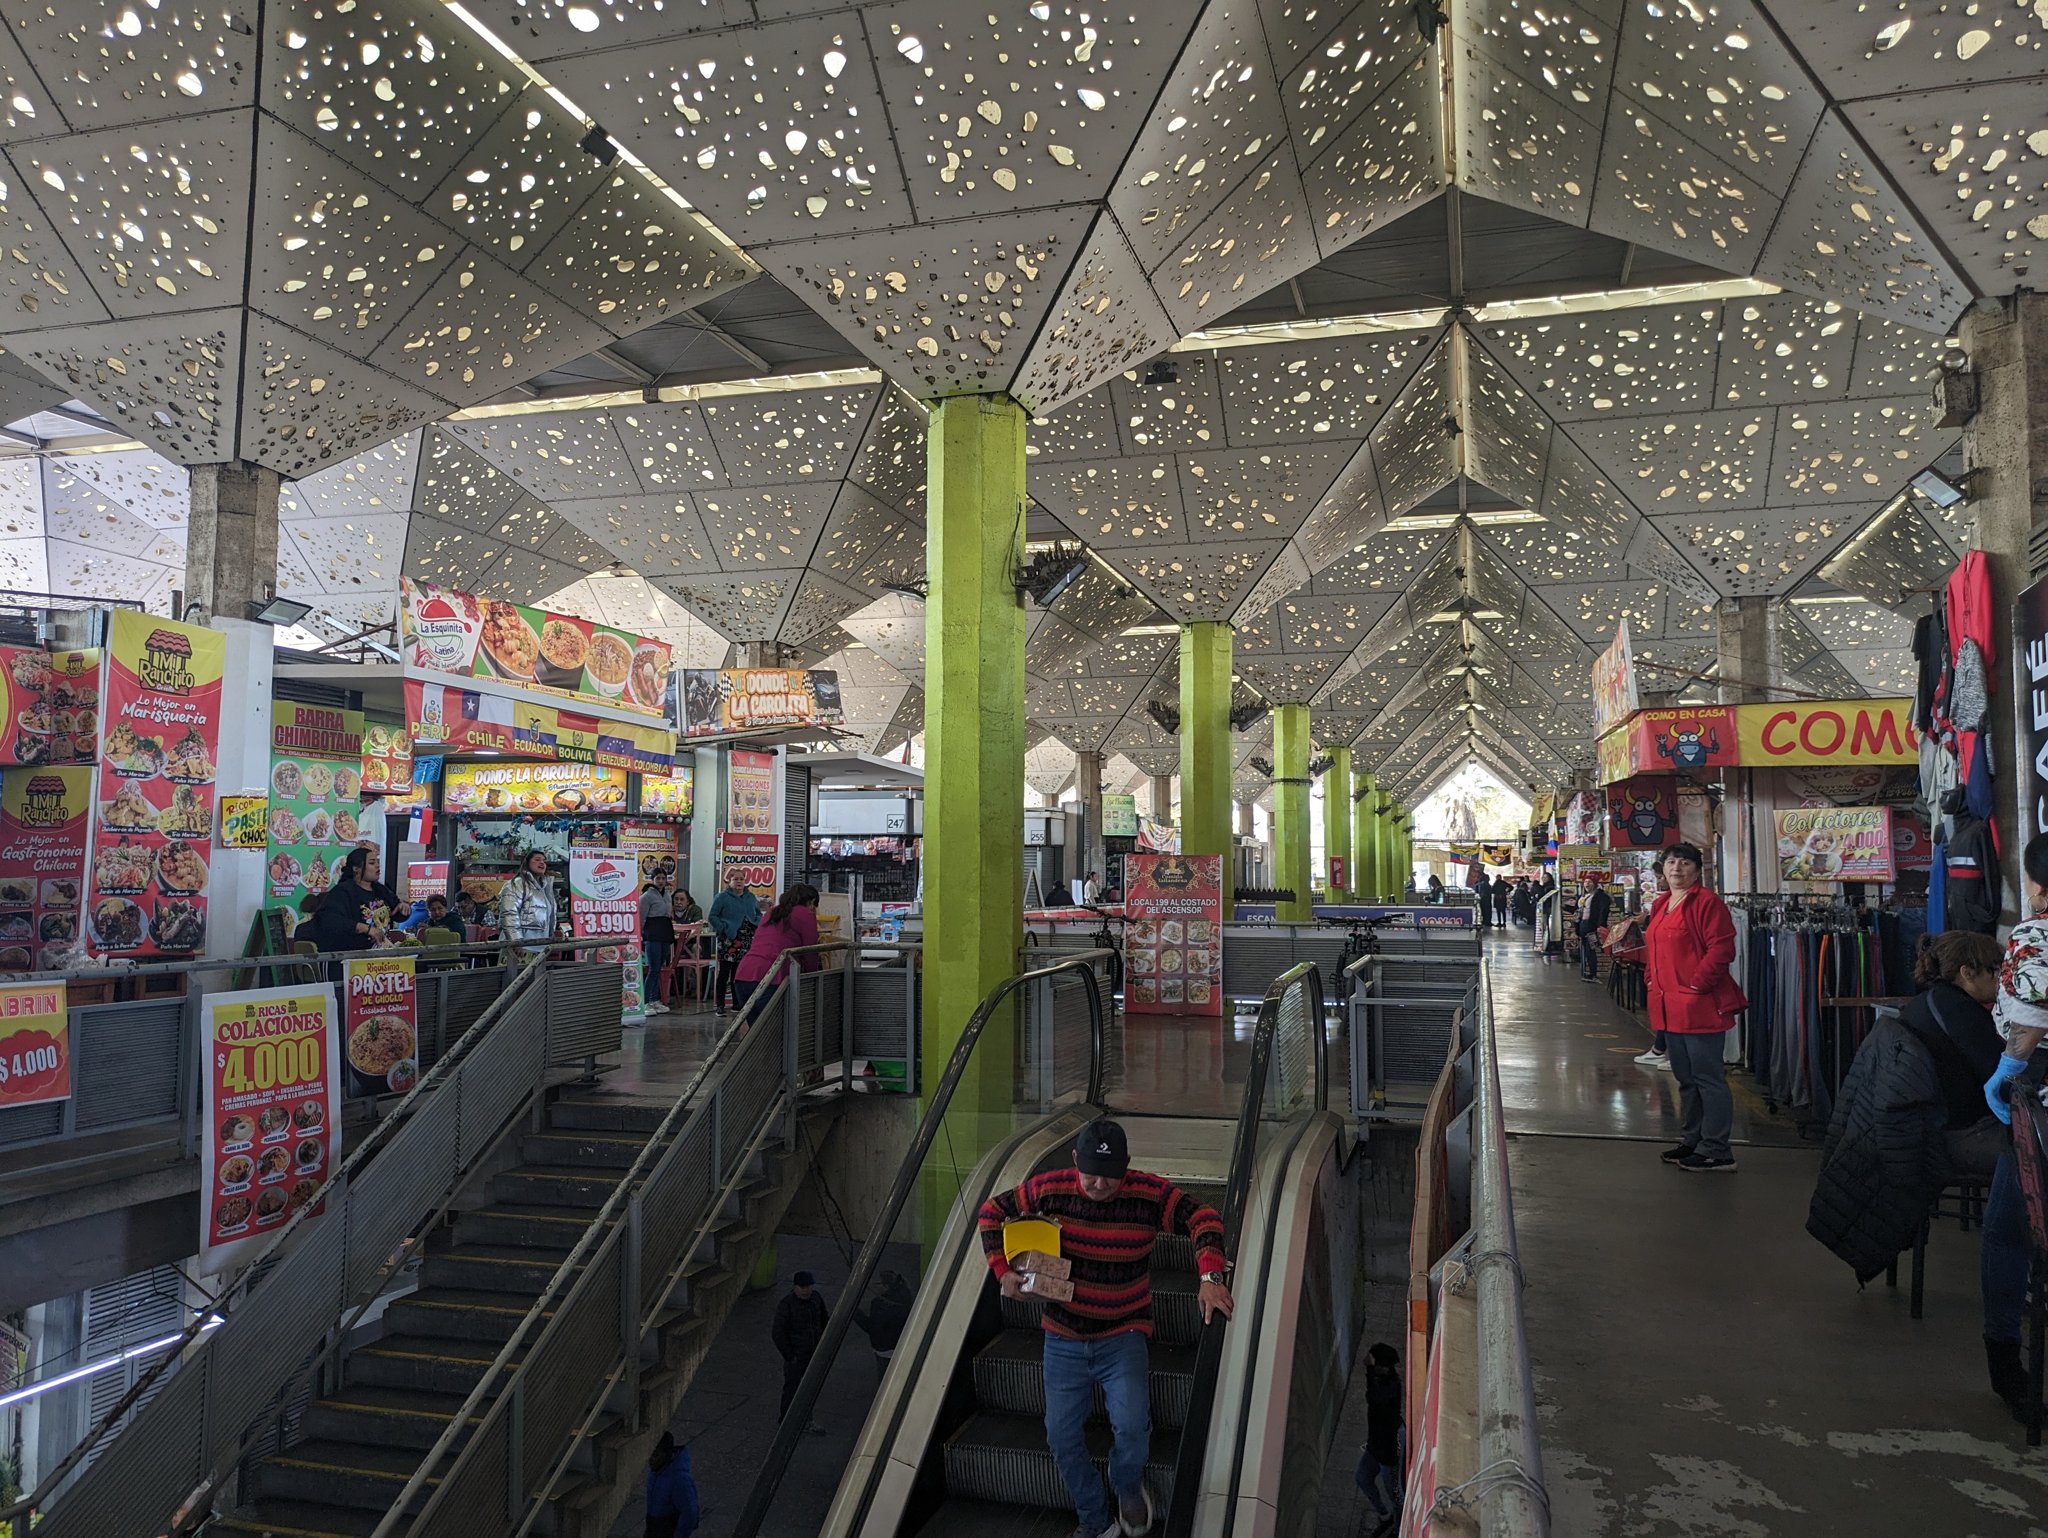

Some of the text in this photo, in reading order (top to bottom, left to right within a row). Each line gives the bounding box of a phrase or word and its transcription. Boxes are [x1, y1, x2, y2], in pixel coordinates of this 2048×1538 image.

[420, 623, 463, 634] La Esquinita
[435, 645, 455, 655] Latina
[140, 660, 194, 690] Ranchito
[746, 673, 788, 693] DONDE
[137, 694, 196, 711] Lo Mejor en
[731, 695, 809, 718] LA CAROLITA
[295, 707, 344, 730] BARRA
[1645, 709, 1726, 720] COMO EN CASA
[275, 725, 361, 752] CHIMBOTANA
[411, 722, 450, 740] PERÚ
[467, 731, 505, 748] CHILE
[514, 739, 553, 756] ECUADOR
[558, 748, 592, 762] BOLIVIA
[597, 753, 631, 768] VENEZUELA
[634, 761, 669, 774] COLOMBIA
[475, 768, 512, 785] DONDE
[516, 767, 535, 782] LA
[536, 764, 590, 781] CAROLITA
[21, 804, 68, 825] Ranchito
[888, 819, 904, 828] 247
[1782, 810, 1884, 834] Colaciones
[15, 836, 26, 844] Lo
[30, 835, 55, 846] Mejor
[1031, 833, 1044, 841] 255
[33, 859, 77, 871] Chilena
[724, 855, 776, 864] COLACIONES
[574, 901, 637, 913] COLACIONES
[351, 972, 414, 997] PASTEL
[0, 994, 57, 1017] BRIN
[362, 996, 373, 1005] DE
[258, 1005, 287, 1017] RICAS
[218, 1012, 323, 1042] COLACIONES
